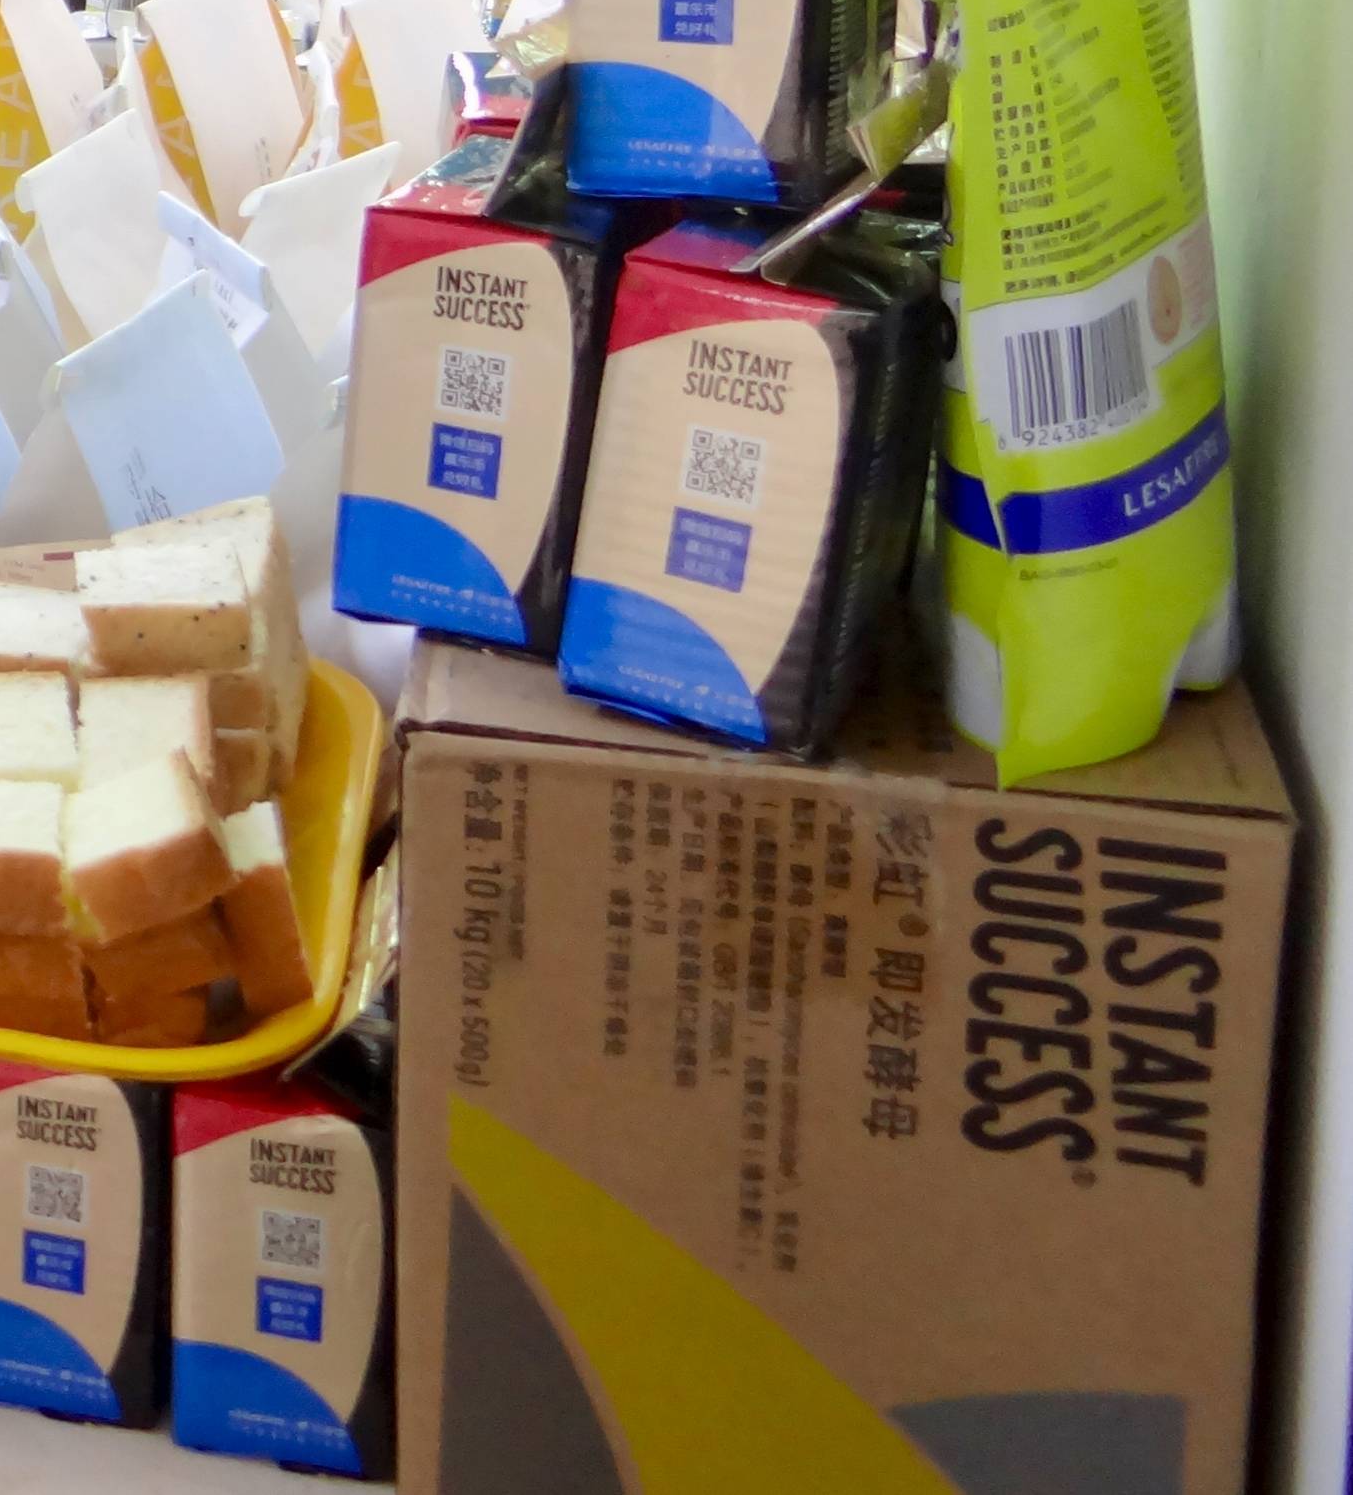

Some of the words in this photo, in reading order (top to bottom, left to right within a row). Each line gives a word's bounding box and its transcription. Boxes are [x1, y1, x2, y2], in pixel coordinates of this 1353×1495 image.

[436, 265, 528, 300] INSTANT
[432, 295, 529, 331] SUCCESS
[688, 339, 793, 382] INSTANT
[681, 372, 788, 415] SUCCESS
[453, 908, 501, 945] kg
[960, 817, 1098, 1166] SUCCESS
[1097, 836, 1229, 1188] INSTANT
[17, 1094, 99, 1125] INSTANT
[16, 1119, 98, 1151] SUCCESS
[249, 1137, 338, 1170] INSTANT
[248, 1163, 336, 1196] SUCCESS
